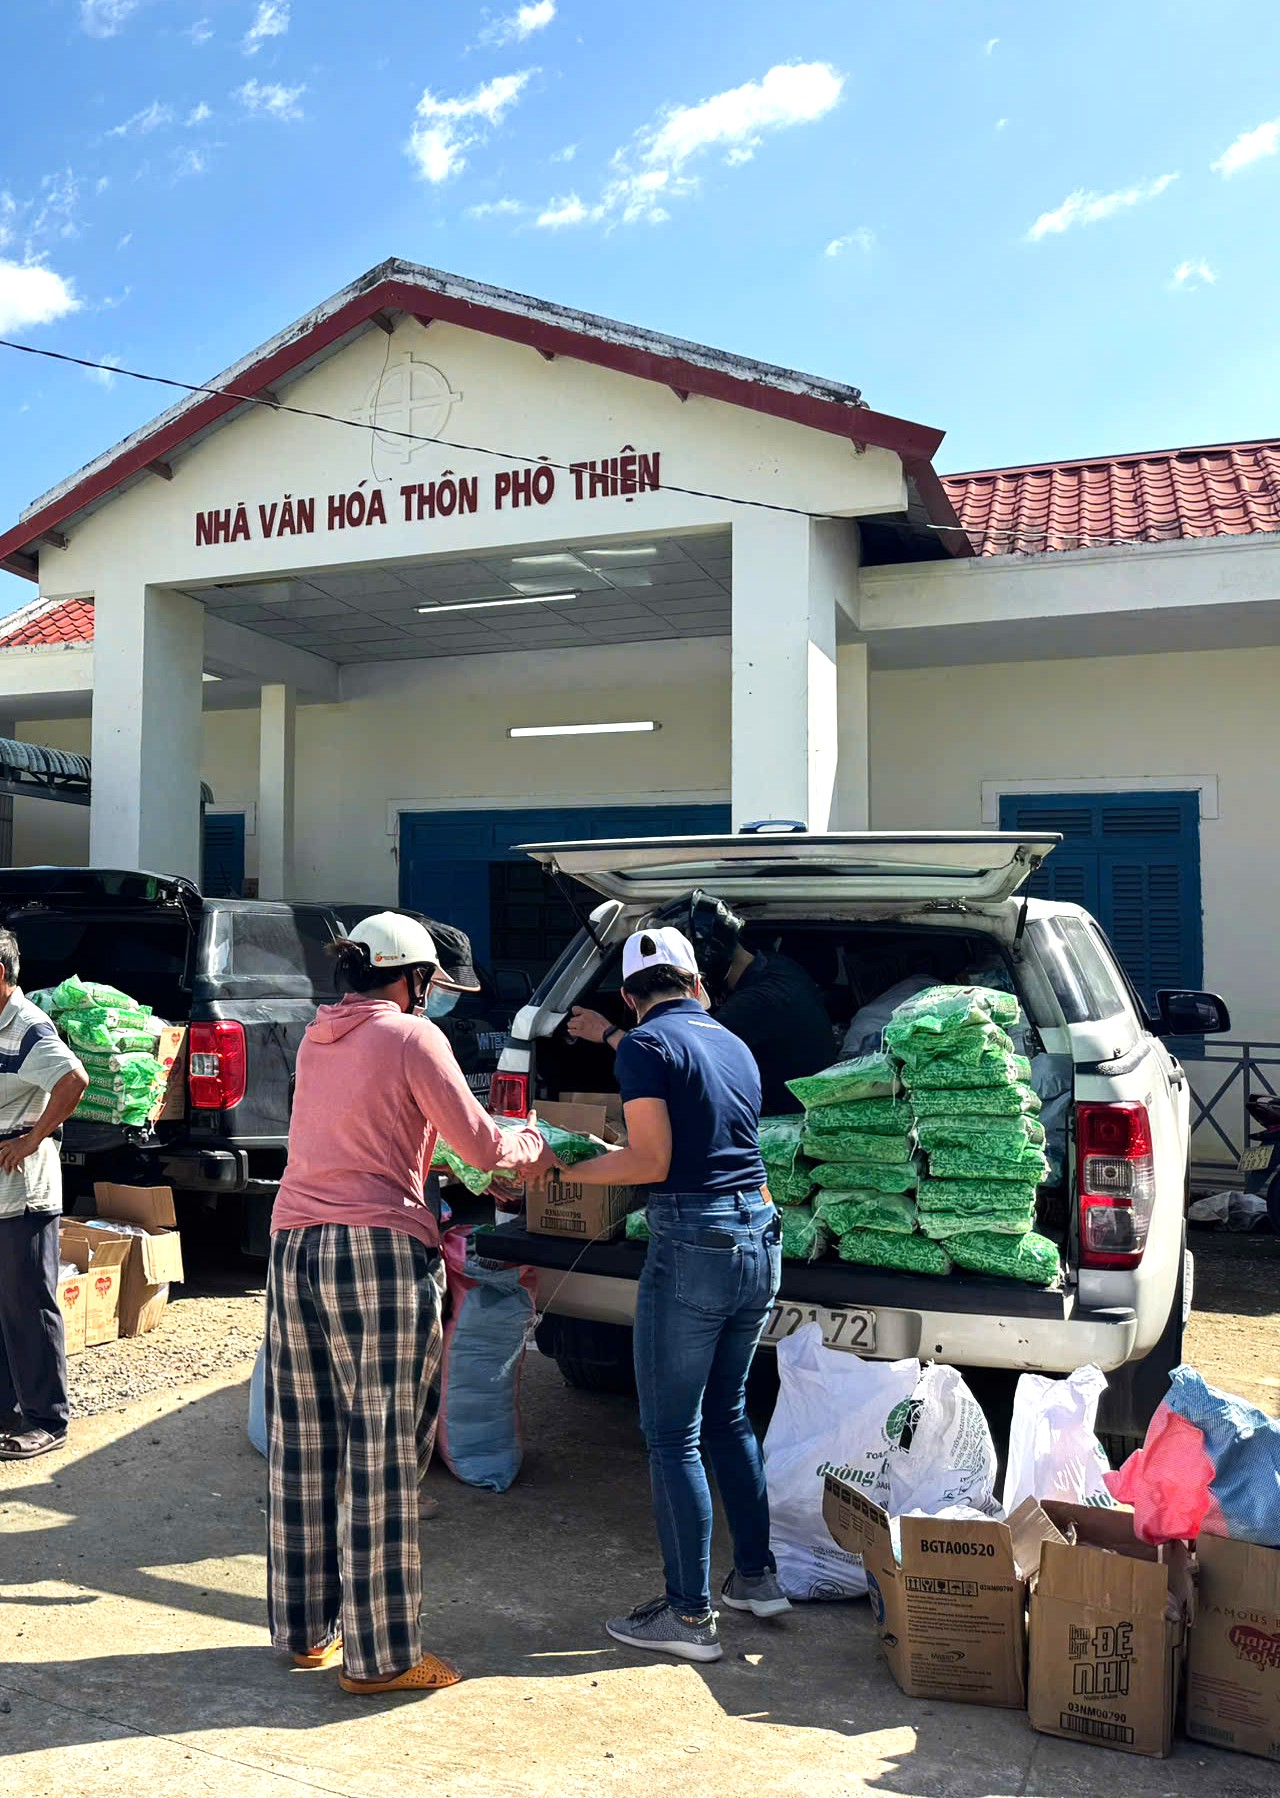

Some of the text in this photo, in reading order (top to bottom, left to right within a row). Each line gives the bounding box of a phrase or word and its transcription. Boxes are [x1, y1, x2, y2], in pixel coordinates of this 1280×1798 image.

[258, 494, 315, 538] VĂN
[327, 480, 387, 531] HÓA
[400, 470, 478, 521] THÔN
[570, 445, 661, 502] THIỆN
[921, 1539, 995, 1557] BGTA00520
[1068, 1702, 1127, 1724] 03NM00790
